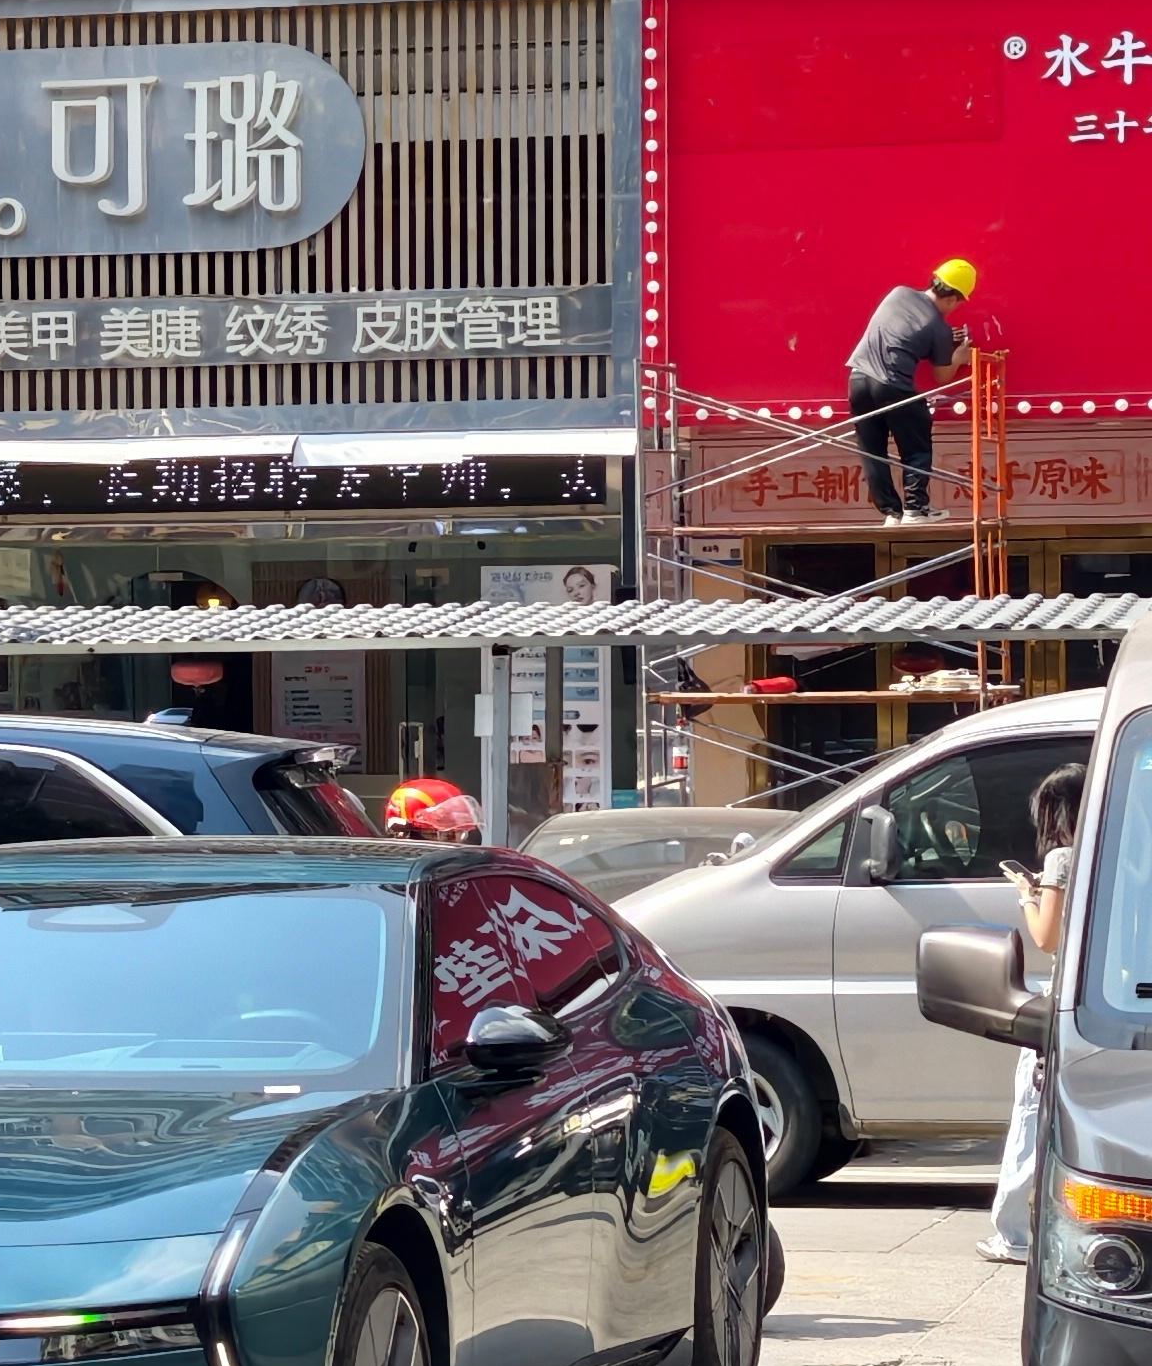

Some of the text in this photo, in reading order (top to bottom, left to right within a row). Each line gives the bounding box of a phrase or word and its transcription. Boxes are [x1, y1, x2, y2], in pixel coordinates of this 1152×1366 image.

[40, 70, 304, 218] 可璐
[225, 302, 328, 358] 纹绣
[352, 295, 562, 354] 皮肤管理
